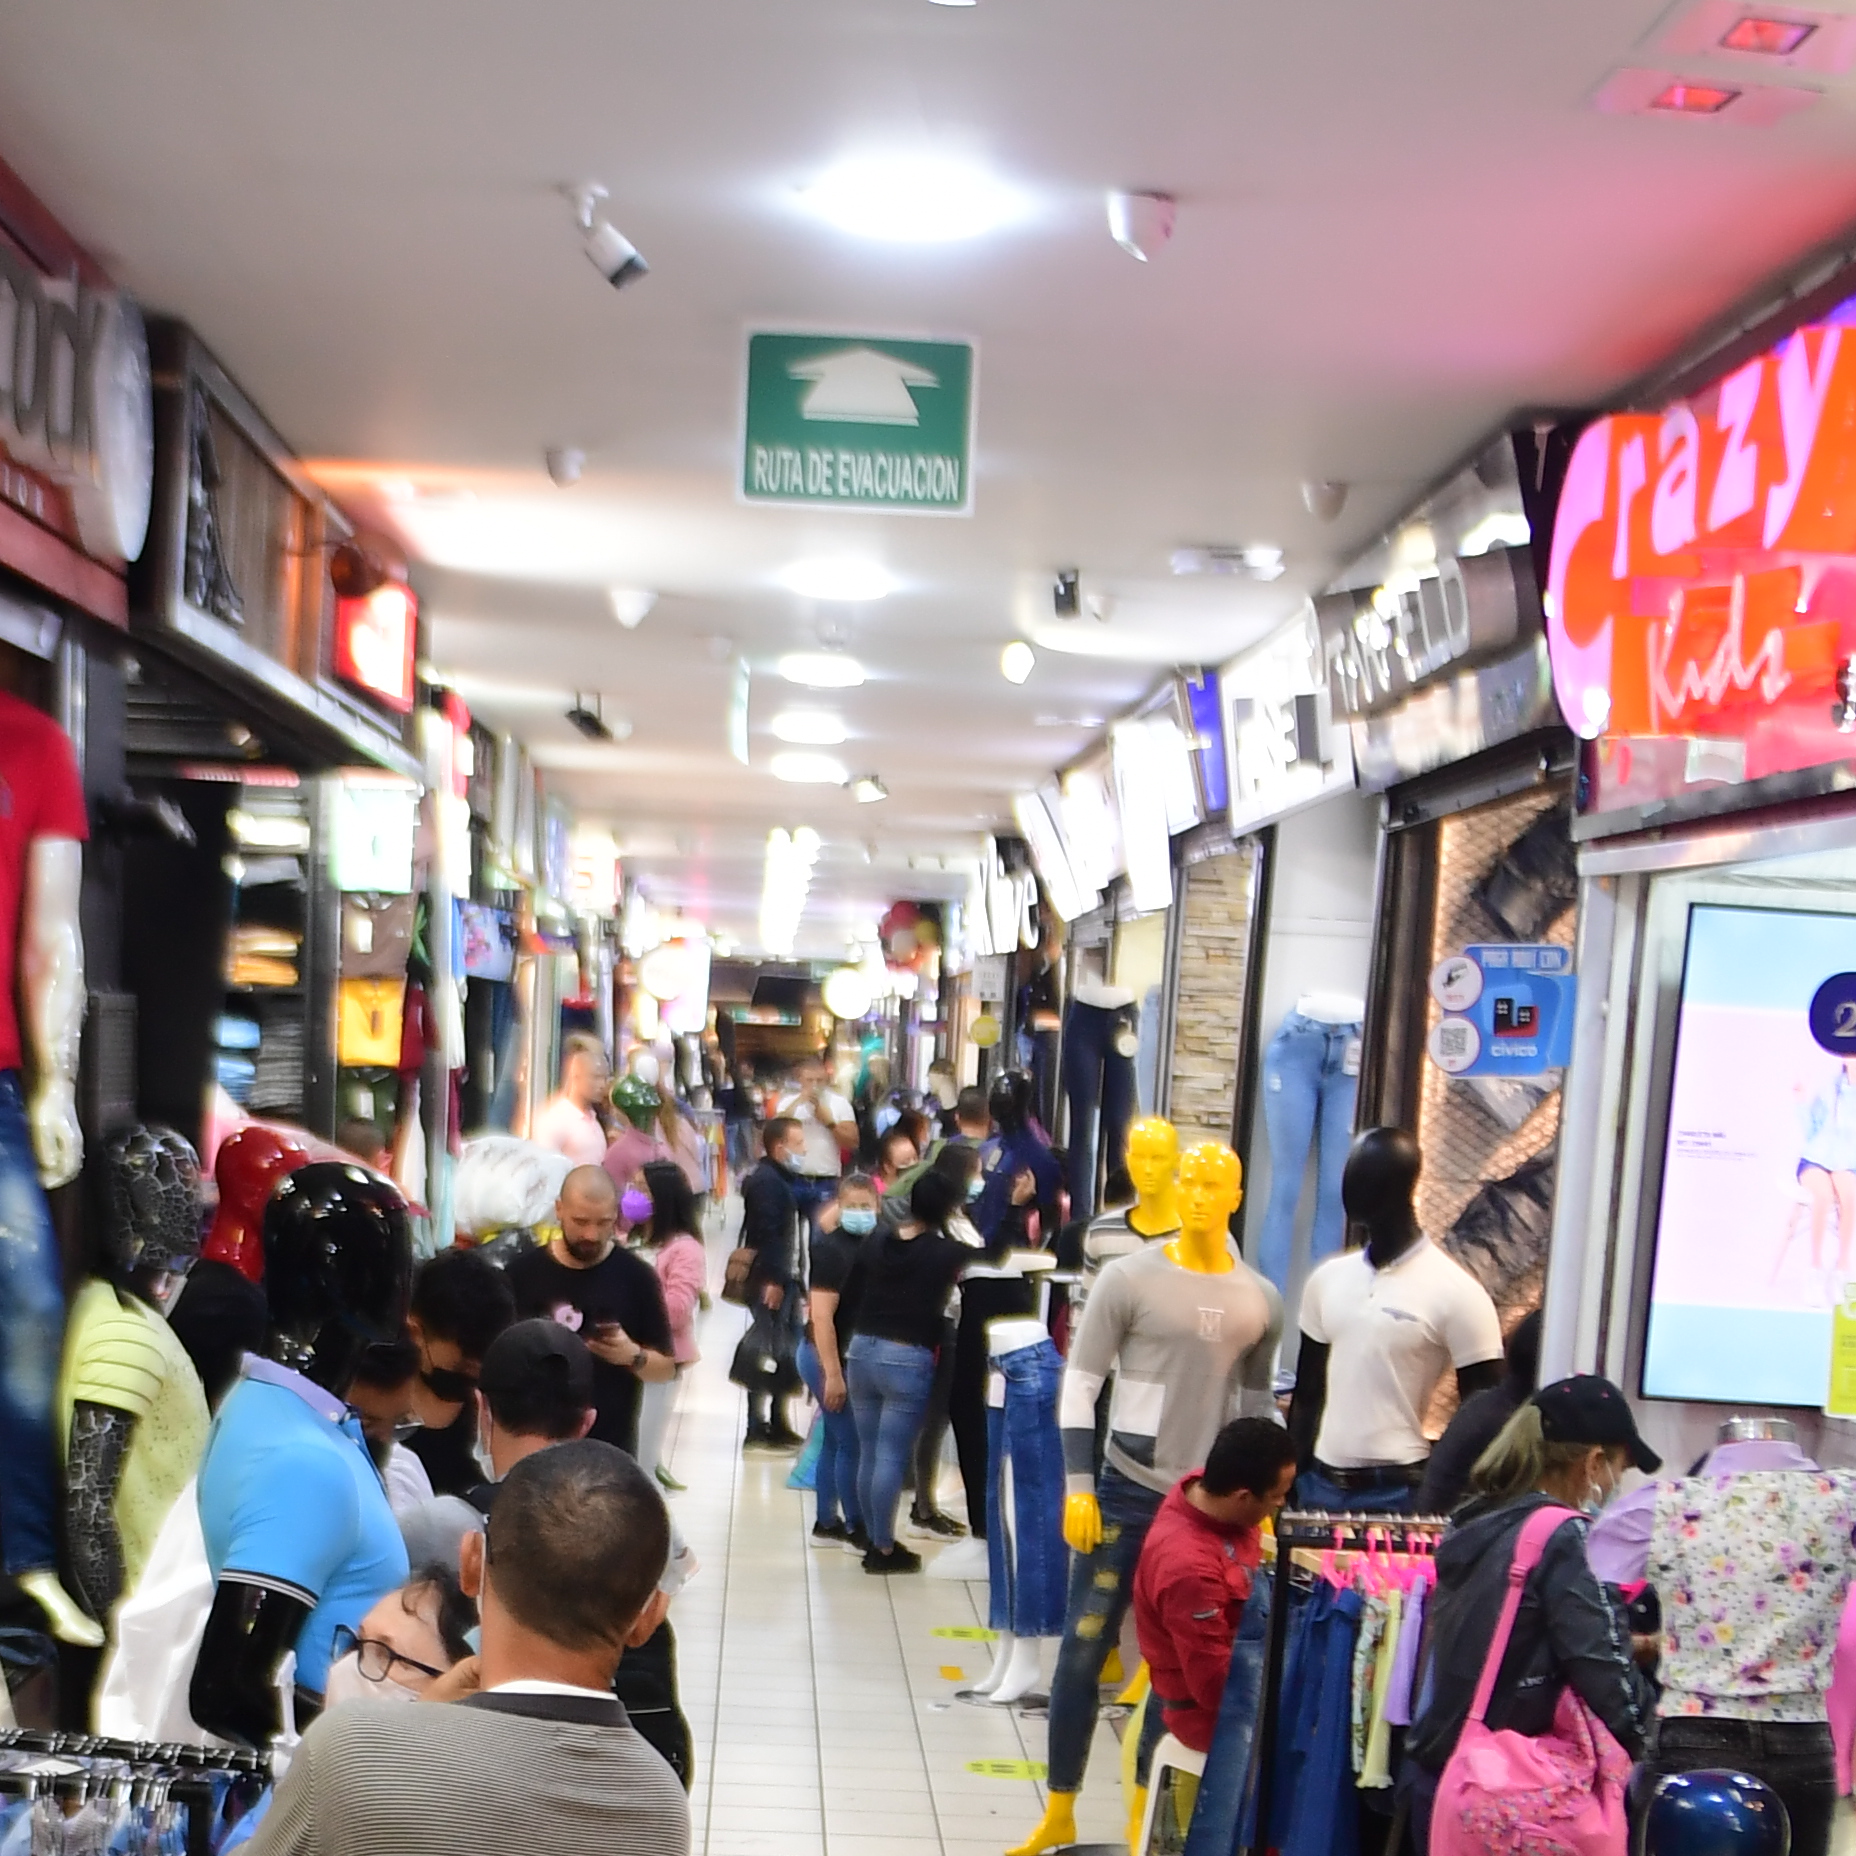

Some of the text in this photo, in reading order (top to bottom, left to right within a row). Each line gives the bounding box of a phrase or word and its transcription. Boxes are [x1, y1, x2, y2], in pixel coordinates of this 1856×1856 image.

[754, 446, 960, 501] RUTA DE EVACUACION
[1546, 325, 1842, 739] Crazy
[1647, 571, 1793, 736] Kids
